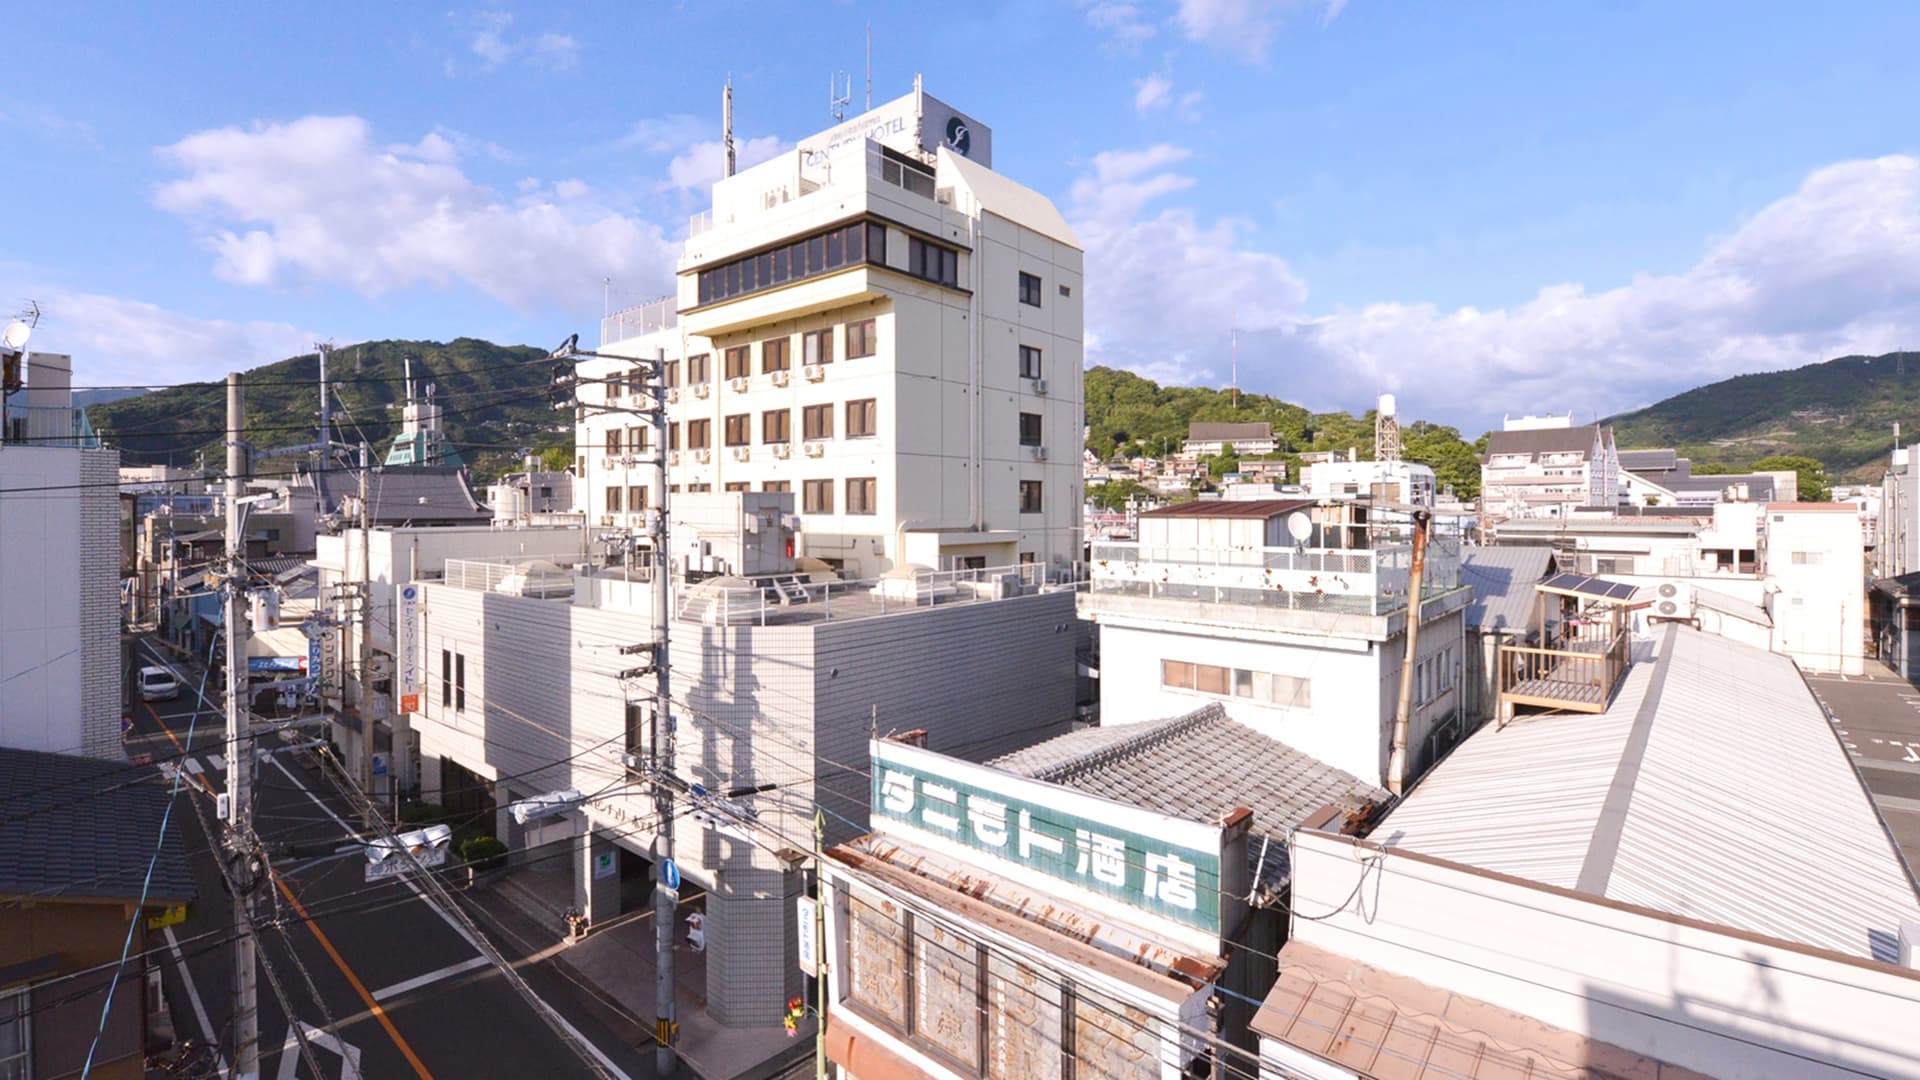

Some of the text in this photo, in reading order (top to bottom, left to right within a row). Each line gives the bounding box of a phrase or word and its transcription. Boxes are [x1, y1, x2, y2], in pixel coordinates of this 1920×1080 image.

[881, 769, 1197, 911] タニモト酒店
